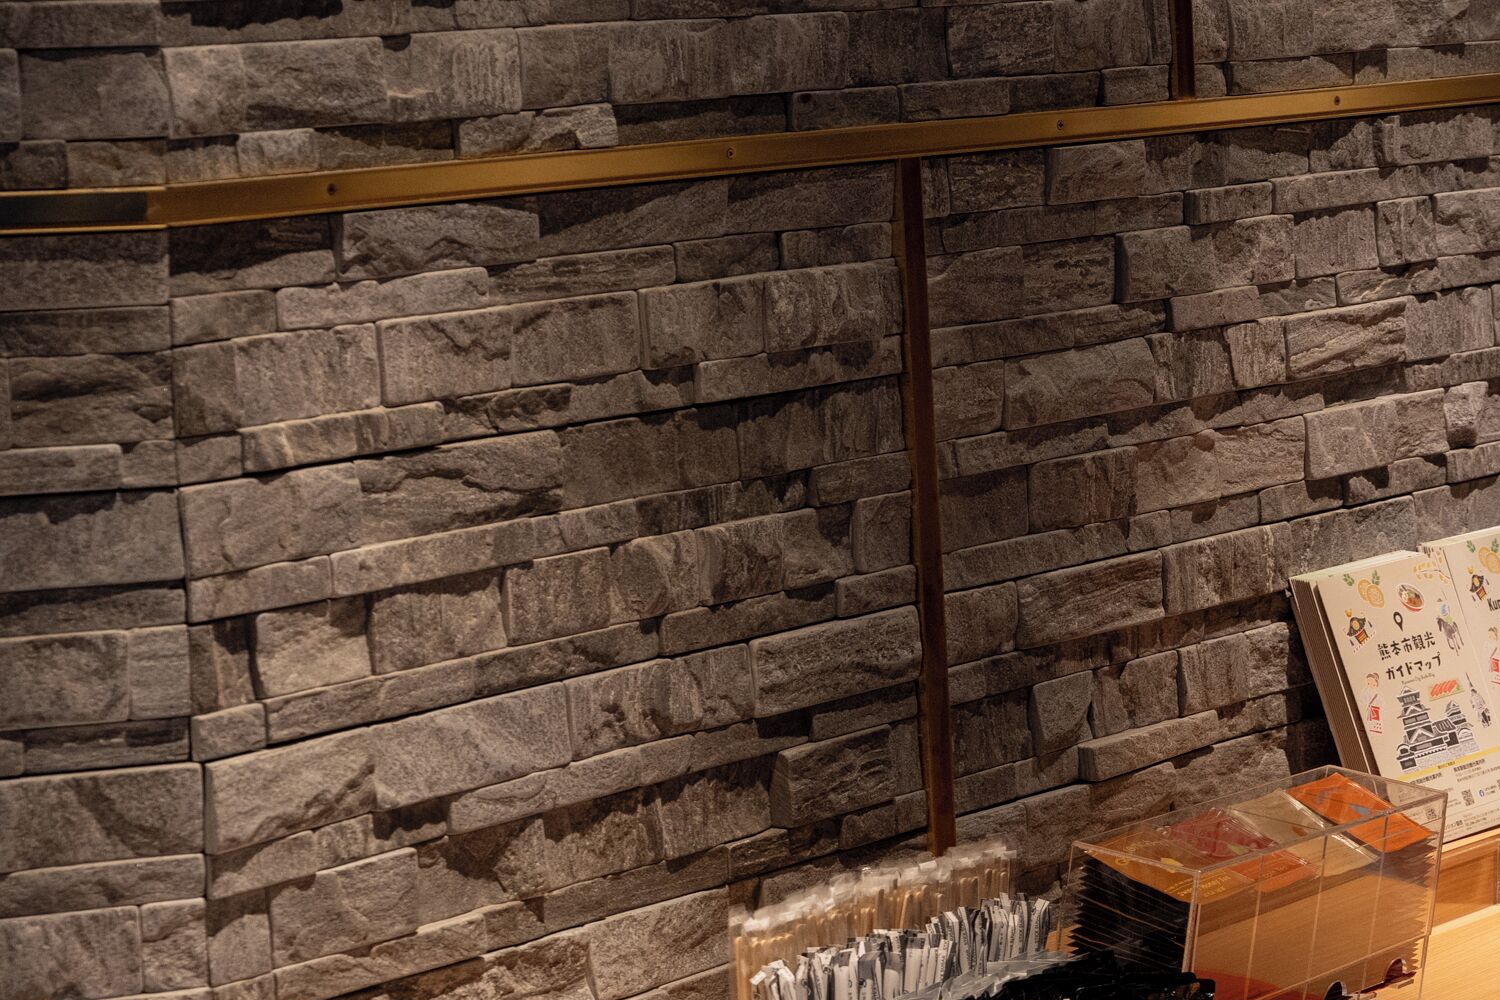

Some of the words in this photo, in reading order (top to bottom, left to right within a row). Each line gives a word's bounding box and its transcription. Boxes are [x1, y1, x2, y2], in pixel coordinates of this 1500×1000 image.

[1378, 631, 1435, 661] 熊本市観光
[1386, 651, 1440, 680] ガイドマップ
